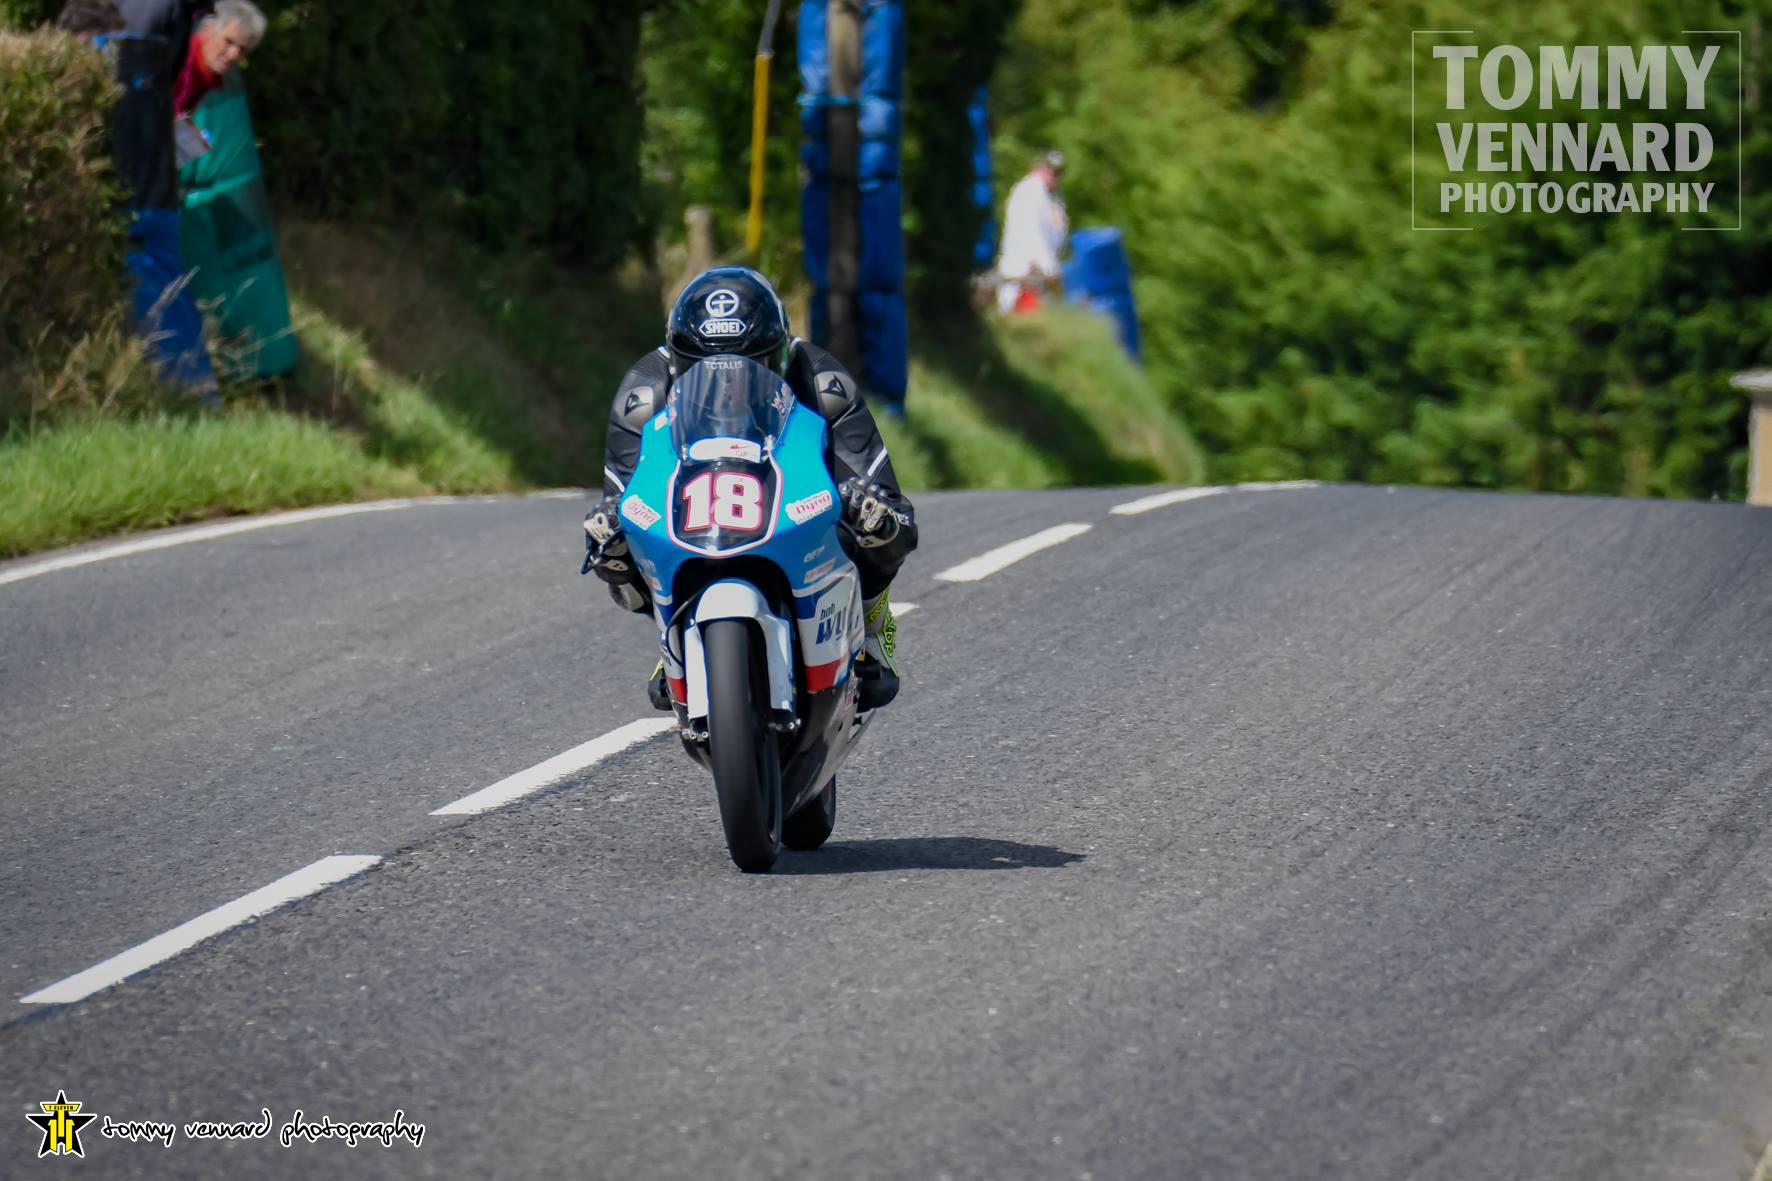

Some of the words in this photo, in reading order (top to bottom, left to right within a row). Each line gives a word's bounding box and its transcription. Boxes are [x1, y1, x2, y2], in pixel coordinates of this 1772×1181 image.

[705, 321, 740, 335] SHOEI
[703, 360, 744, 370] TOTALIS
[683, 471, 763, 531] 18
